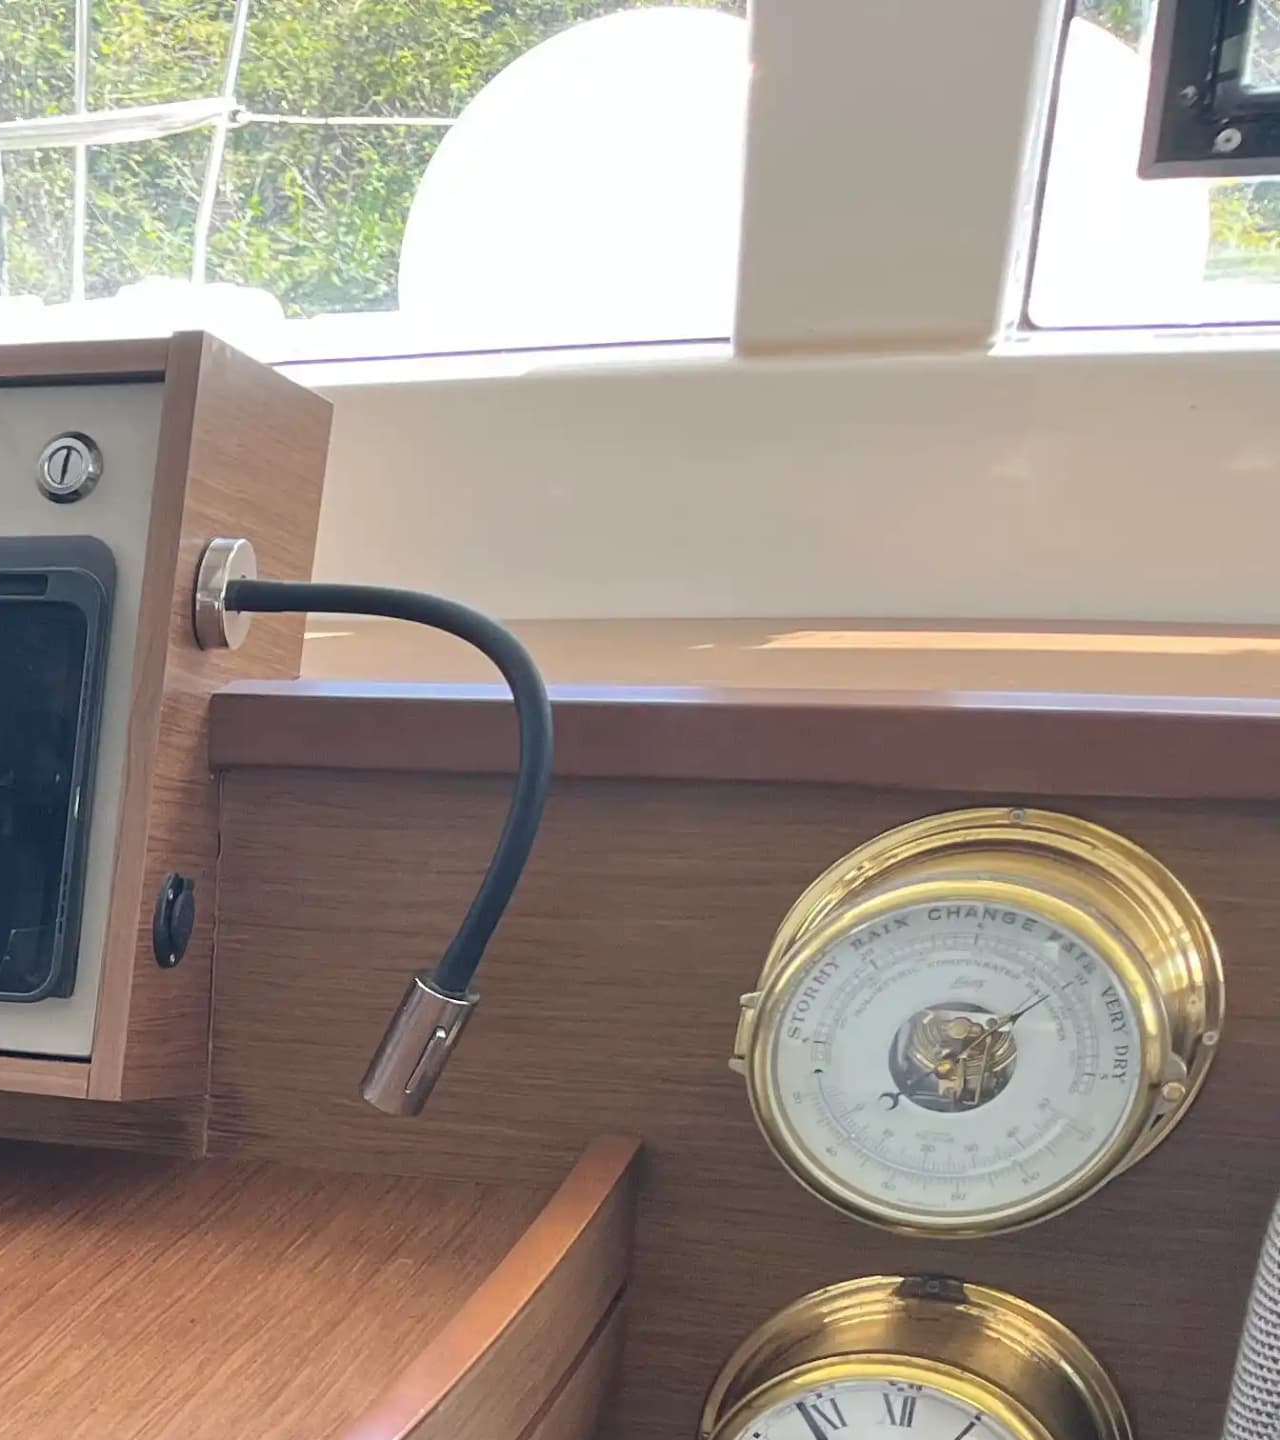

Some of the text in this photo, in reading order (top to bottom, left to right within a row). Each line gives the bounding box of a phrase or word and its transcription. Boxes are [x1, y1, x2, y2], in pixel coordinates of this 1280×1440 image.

[928, 906, 1038, 933] CHANGE
[786, 955, 842, 1040] STORMY
[1099, 987, 1131, 1083] VERY DRY
[880, 1392, 917, 1429] XII
